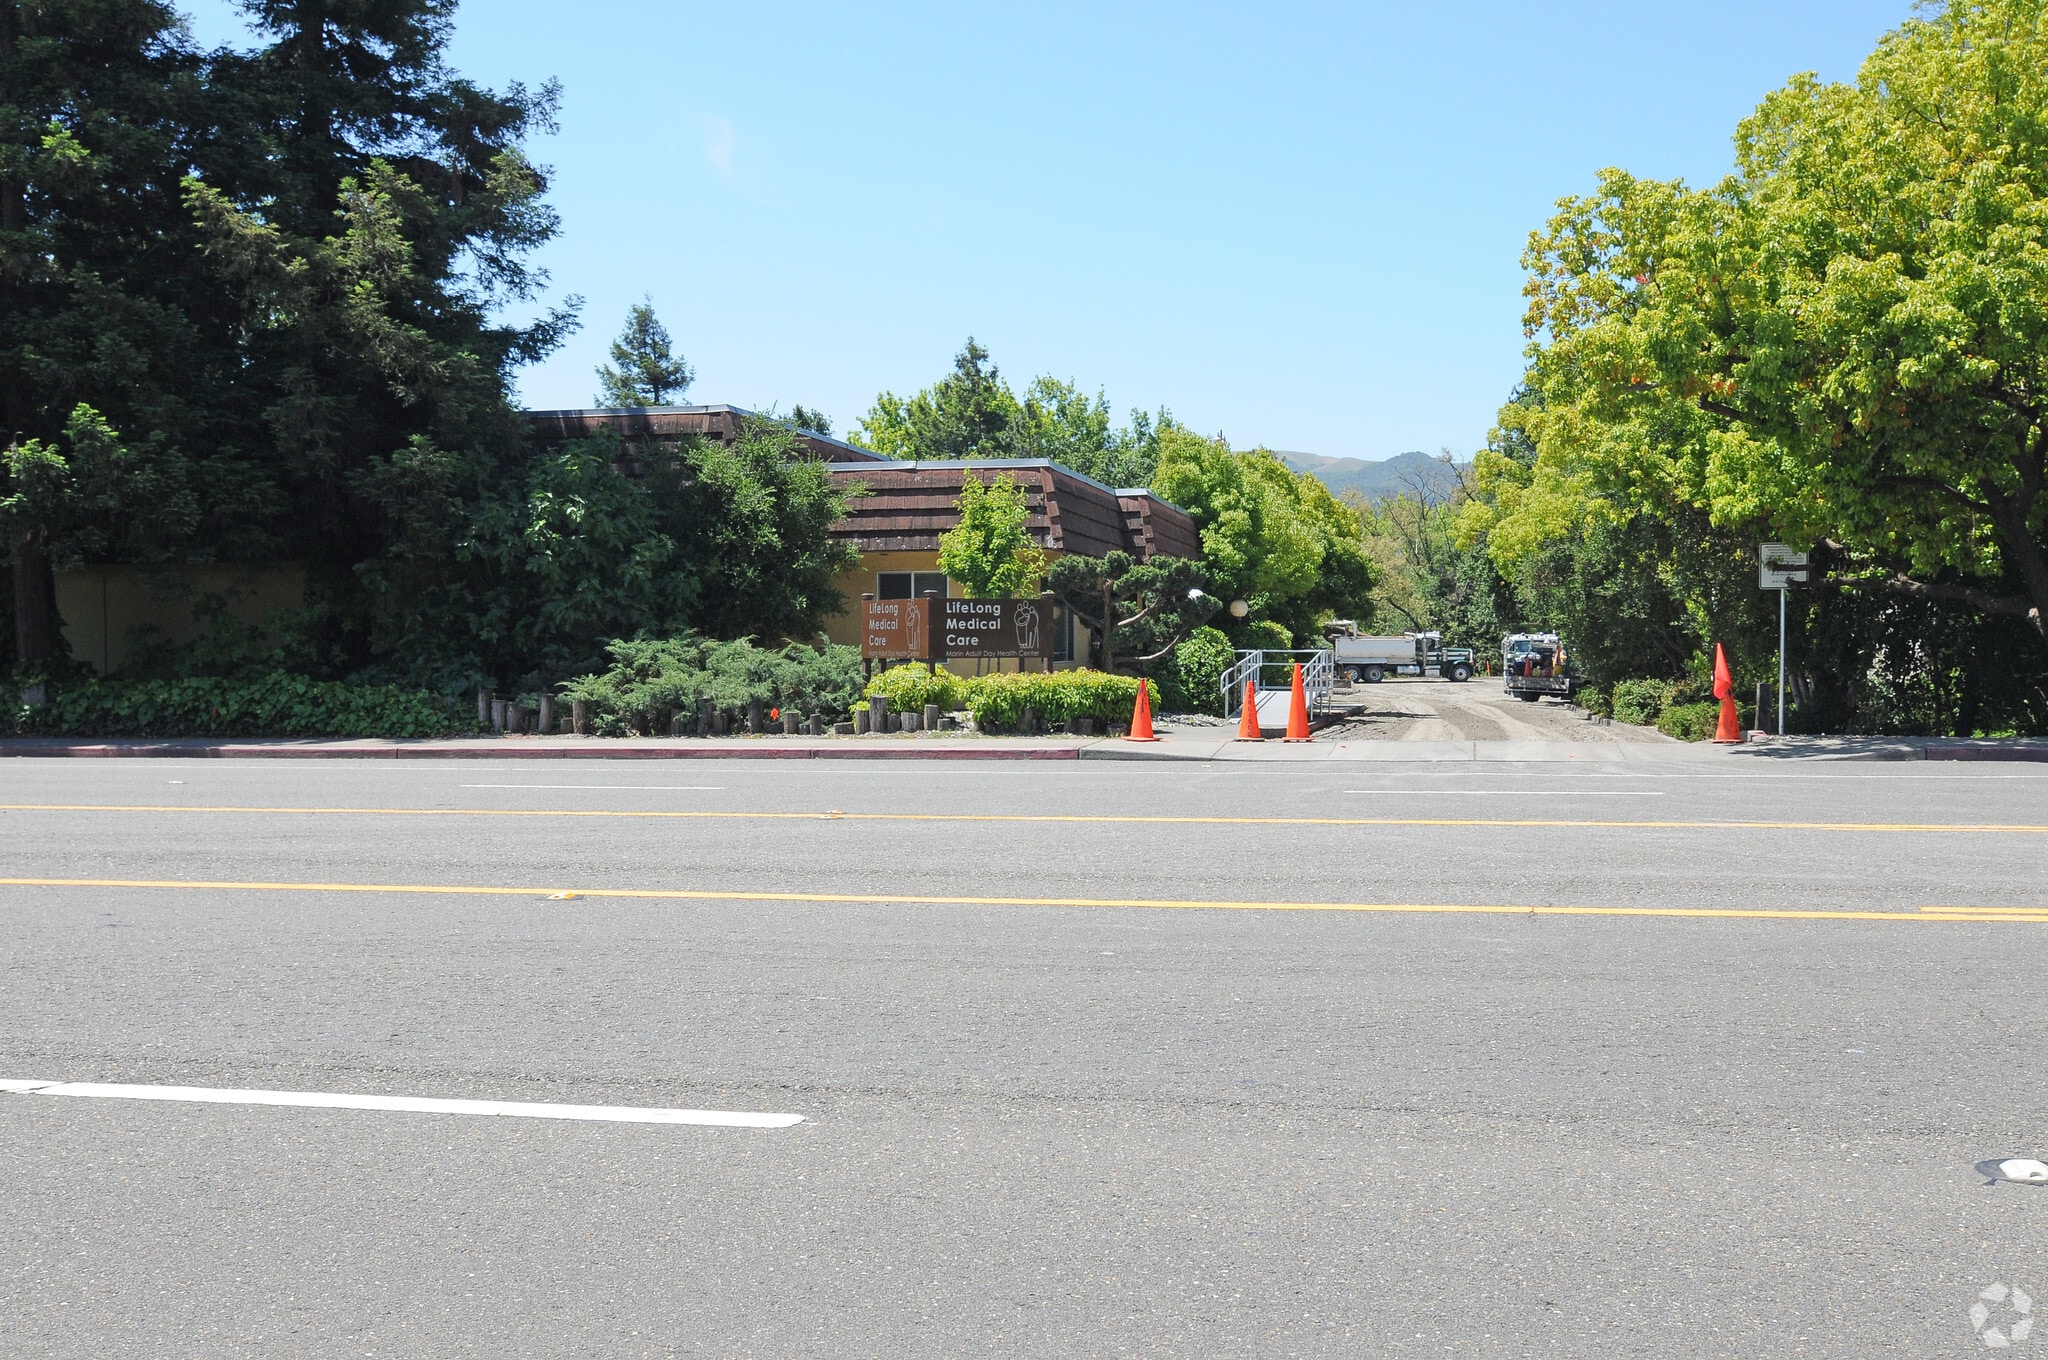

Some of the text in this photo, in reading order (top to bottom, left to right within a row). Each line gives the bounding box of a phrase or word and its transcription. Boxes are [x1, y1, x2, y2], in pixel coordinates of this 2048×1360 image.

[869, 603, 898, 616] LifeLong
[946, 602, 1001, 616] LifeLong
[869, 618, 898, 630] Medical
[946, 618, 1001, 630] Medical
[869, 634, 887, 646] Care
[946, 634, 979, 646] Care
[983, 650, 996, 658] Day
[1019, 649, 1040, 657] Center
